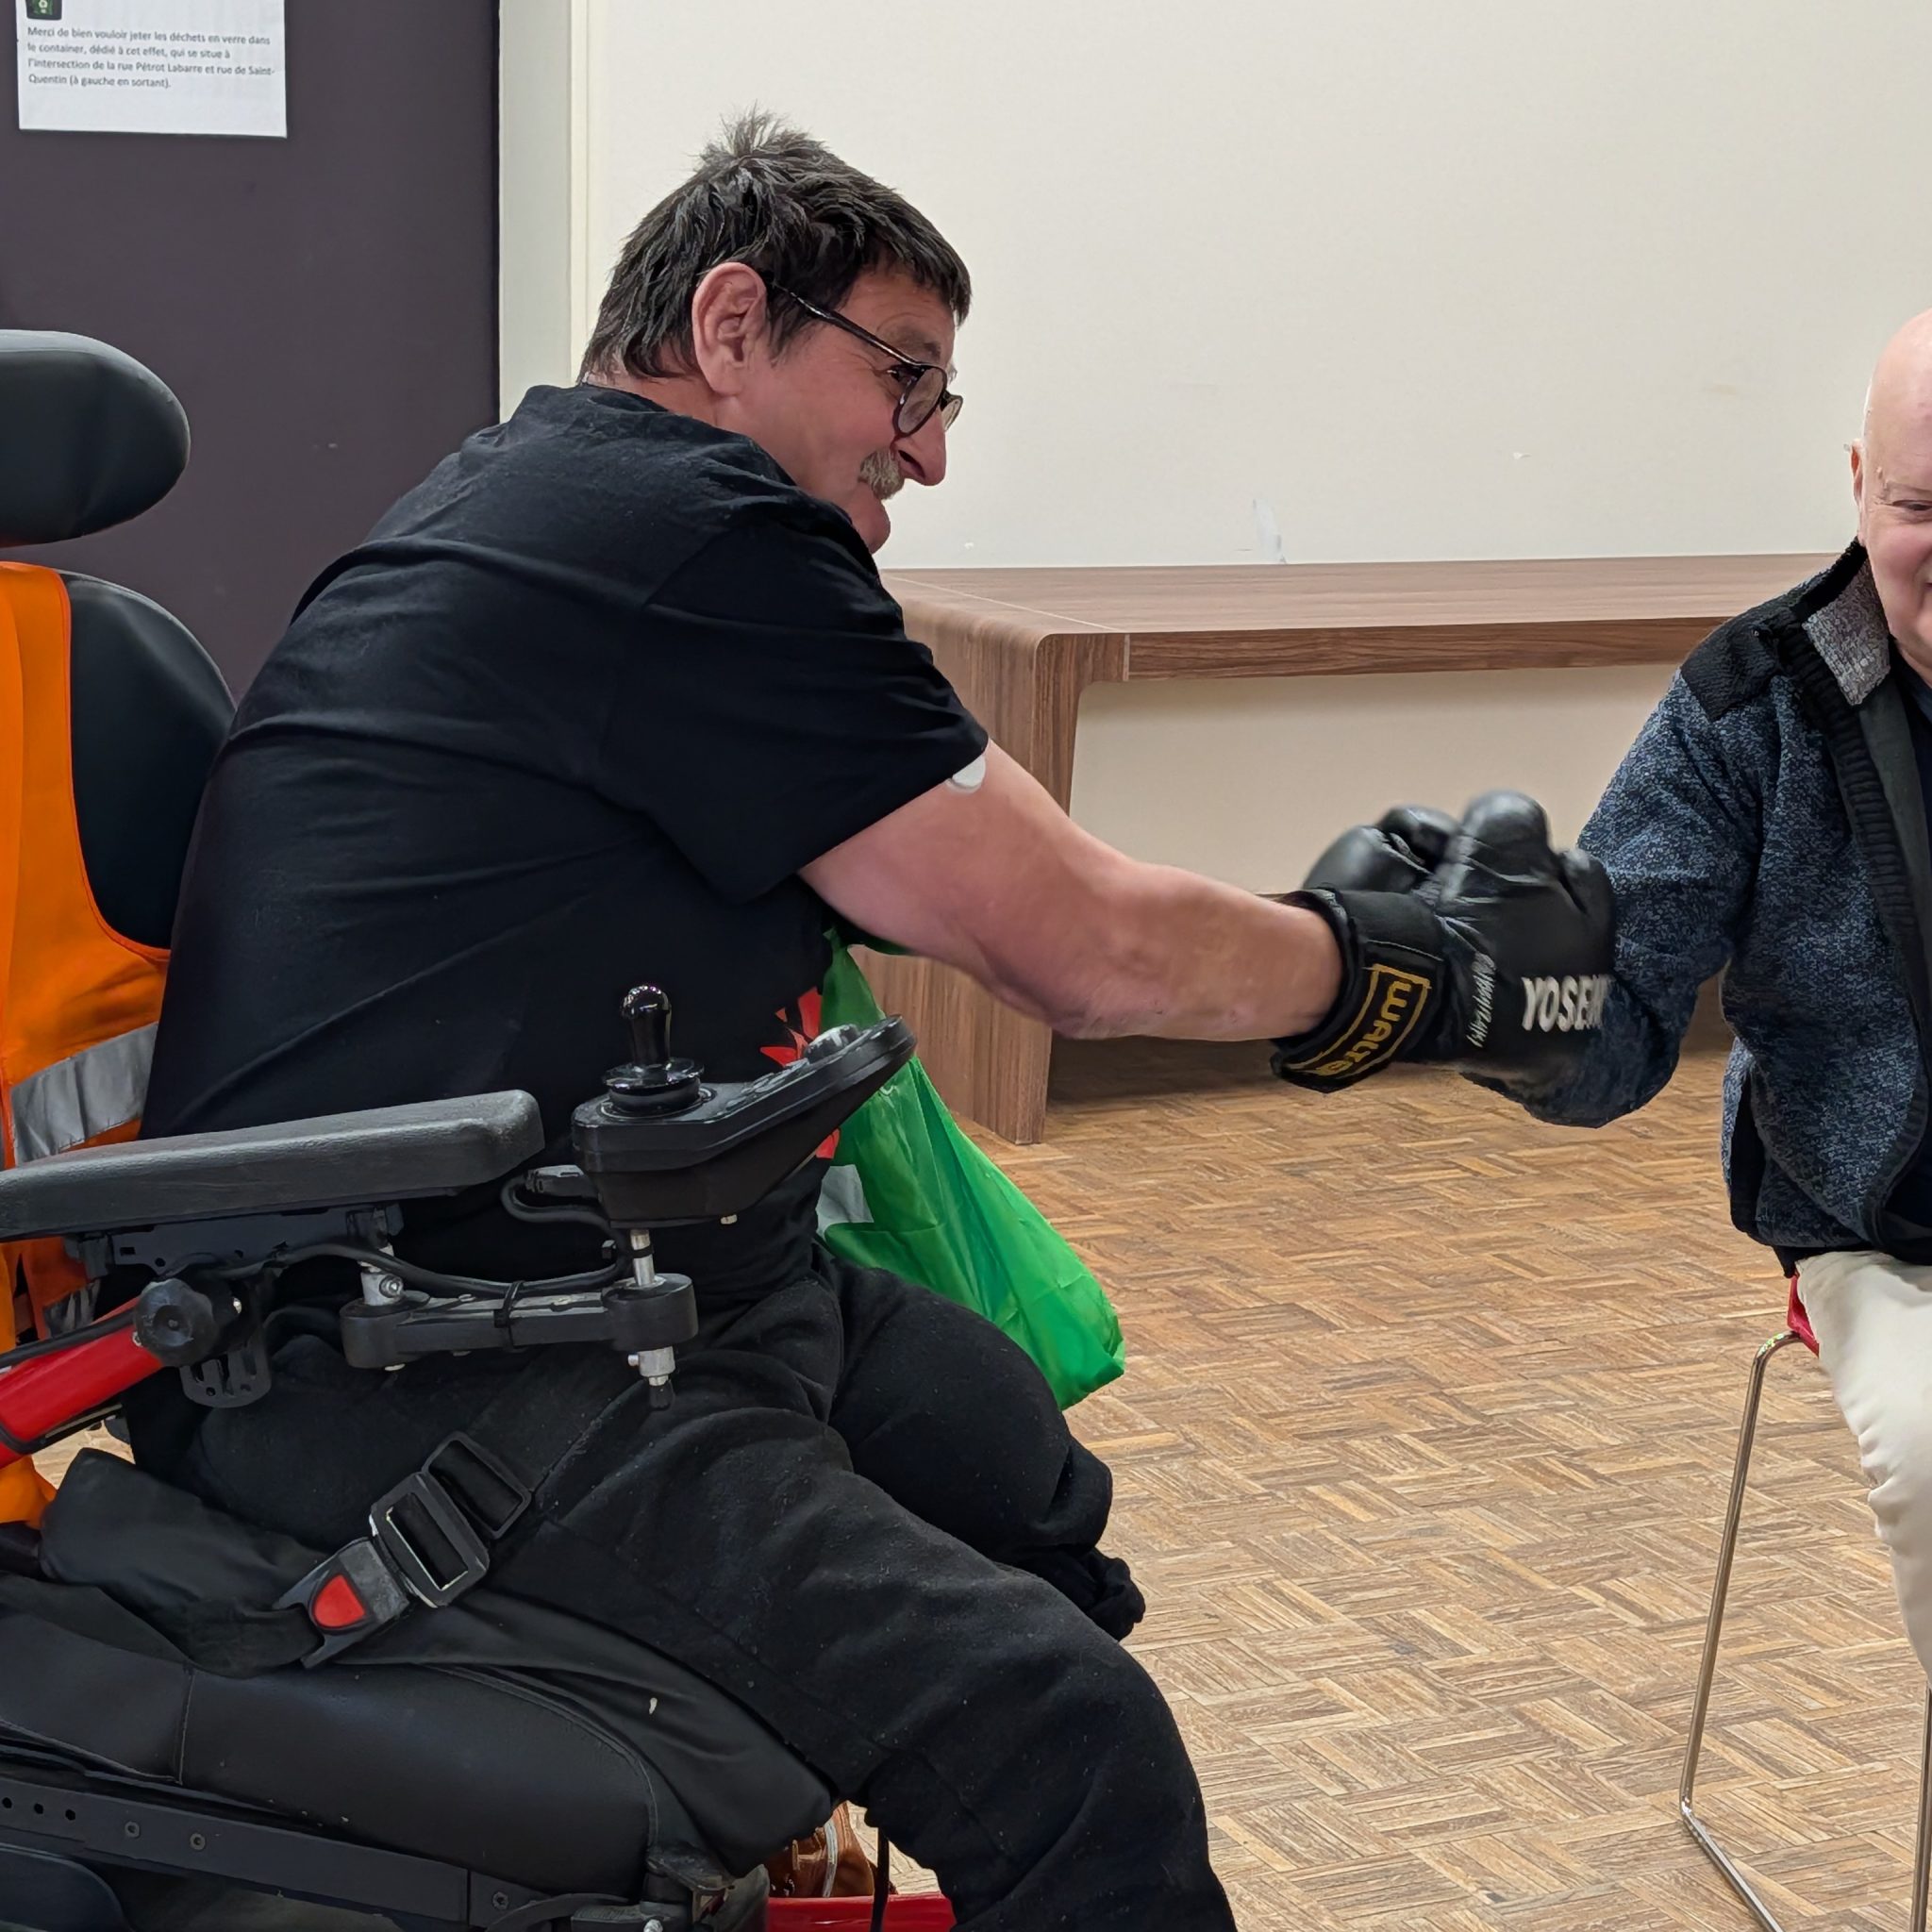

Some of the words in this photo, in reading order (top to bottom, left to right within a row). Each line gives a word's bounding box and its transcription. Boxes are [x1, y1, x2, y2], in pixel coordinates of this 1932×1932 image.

[27, 26, 55, 37] Merci
[72, 27, 92, 38] bien
[94, 29, 127, 39] vouloir
[129, 31, 151, 42] jeter
[155, 31, 167, 42] les
[170, 31, 206, 42] déchets
[208, 34, 220, 42] en
[222, 36, 246, 44] verre
[248, 35, 271, 45] dans
[39, 43, 87, 55] container,
[90, 44, 115, 55] dédié
[142, 47, 168, 58] effet,
[170, 48, 185, 58] qui
[200, 49, 223, 58] situe
[92, 60, 105, 70] de
[107, 60, 115, 70] la
[118, 62, 133, 71] rue
[168, 63, 203, 73] Labarre
[205, 64, 215, 74] et
[217, 65, 232, 75] rue
[28, 74, 67, 85] Quentin
[81, 76, 114, 87] gauche
[117, 77, 129, 86] en
